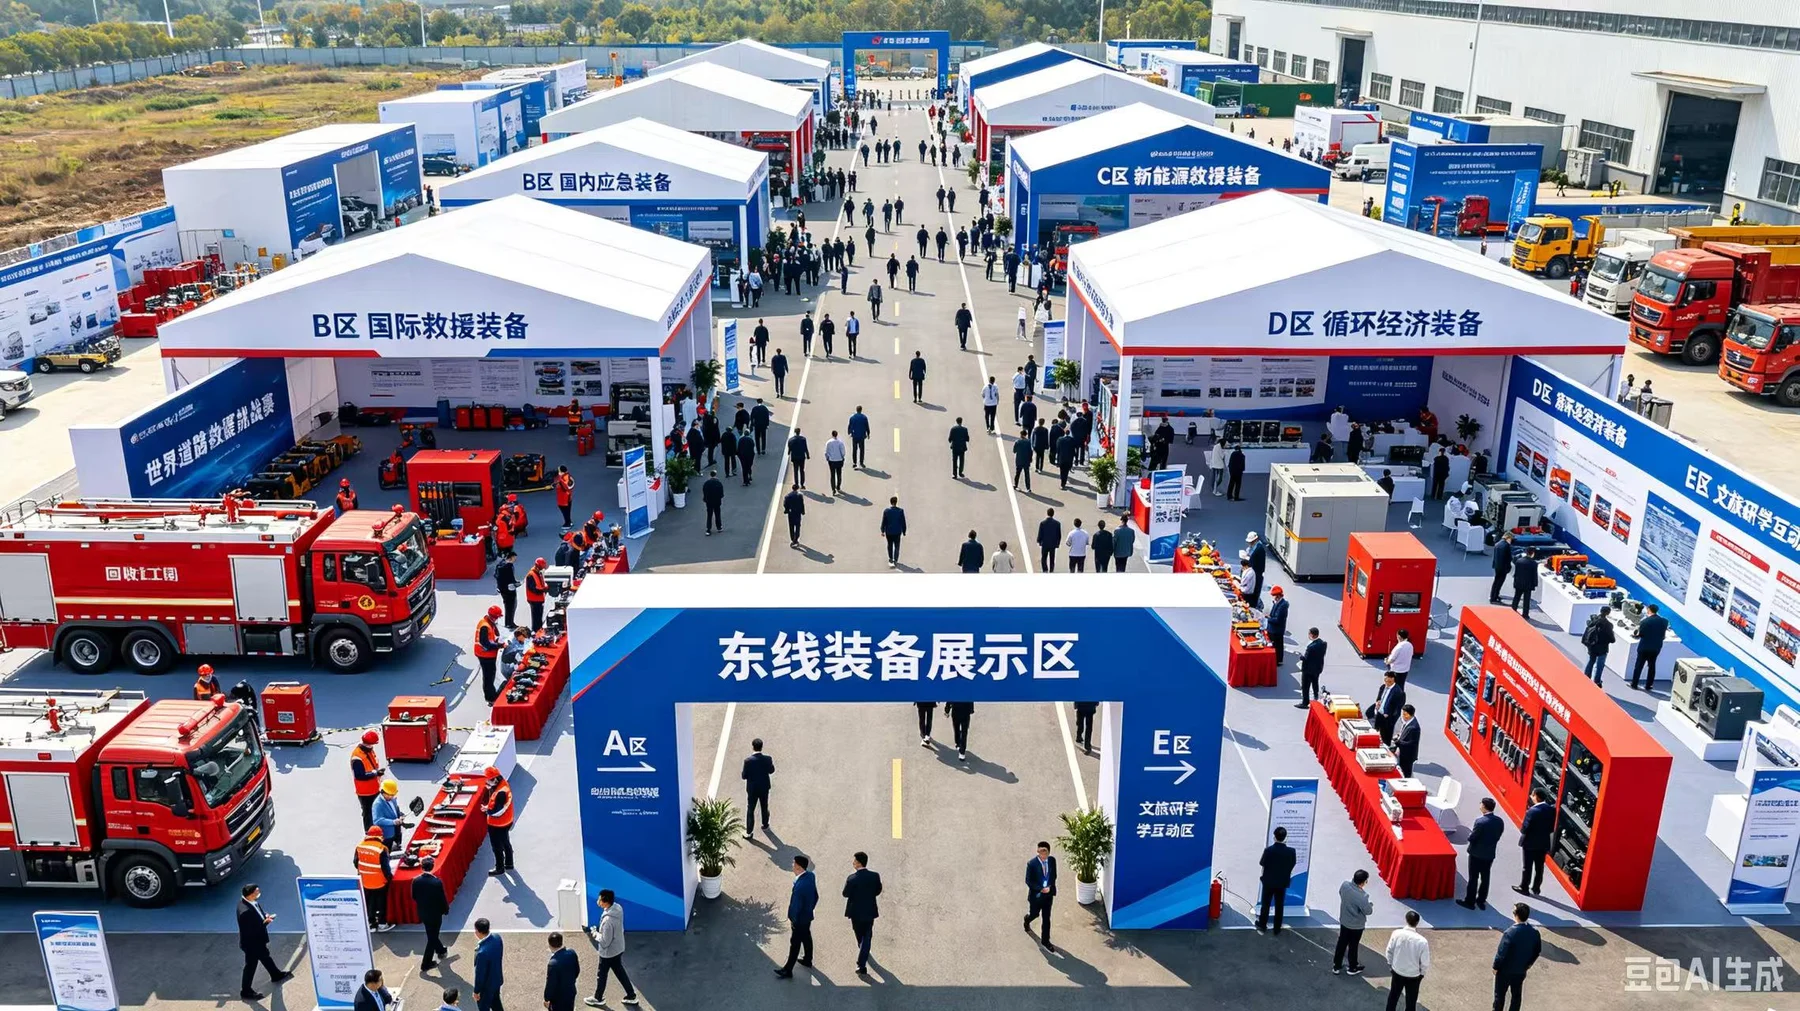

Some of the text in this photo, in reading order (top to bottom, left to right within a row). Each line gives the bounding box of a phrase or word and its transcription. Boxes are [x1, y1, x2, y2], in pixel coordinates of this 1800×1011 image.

[522, 172, 672, 193] B区 国内应急装备
[1097, 166, 1129, 186] C区
[312, 311, 529, 340] B区 国际救援装备
[1268, 309, 1484, 338] D区 循环经济装备
[1532, 378, 1553, 405] D区
[1685, 464, 1713, 499] E区
[718, 631, 1080, 681] 东线装备展示区
[603, 729, 648, 756] A区
[1153, 729, 1192, 755] E区
